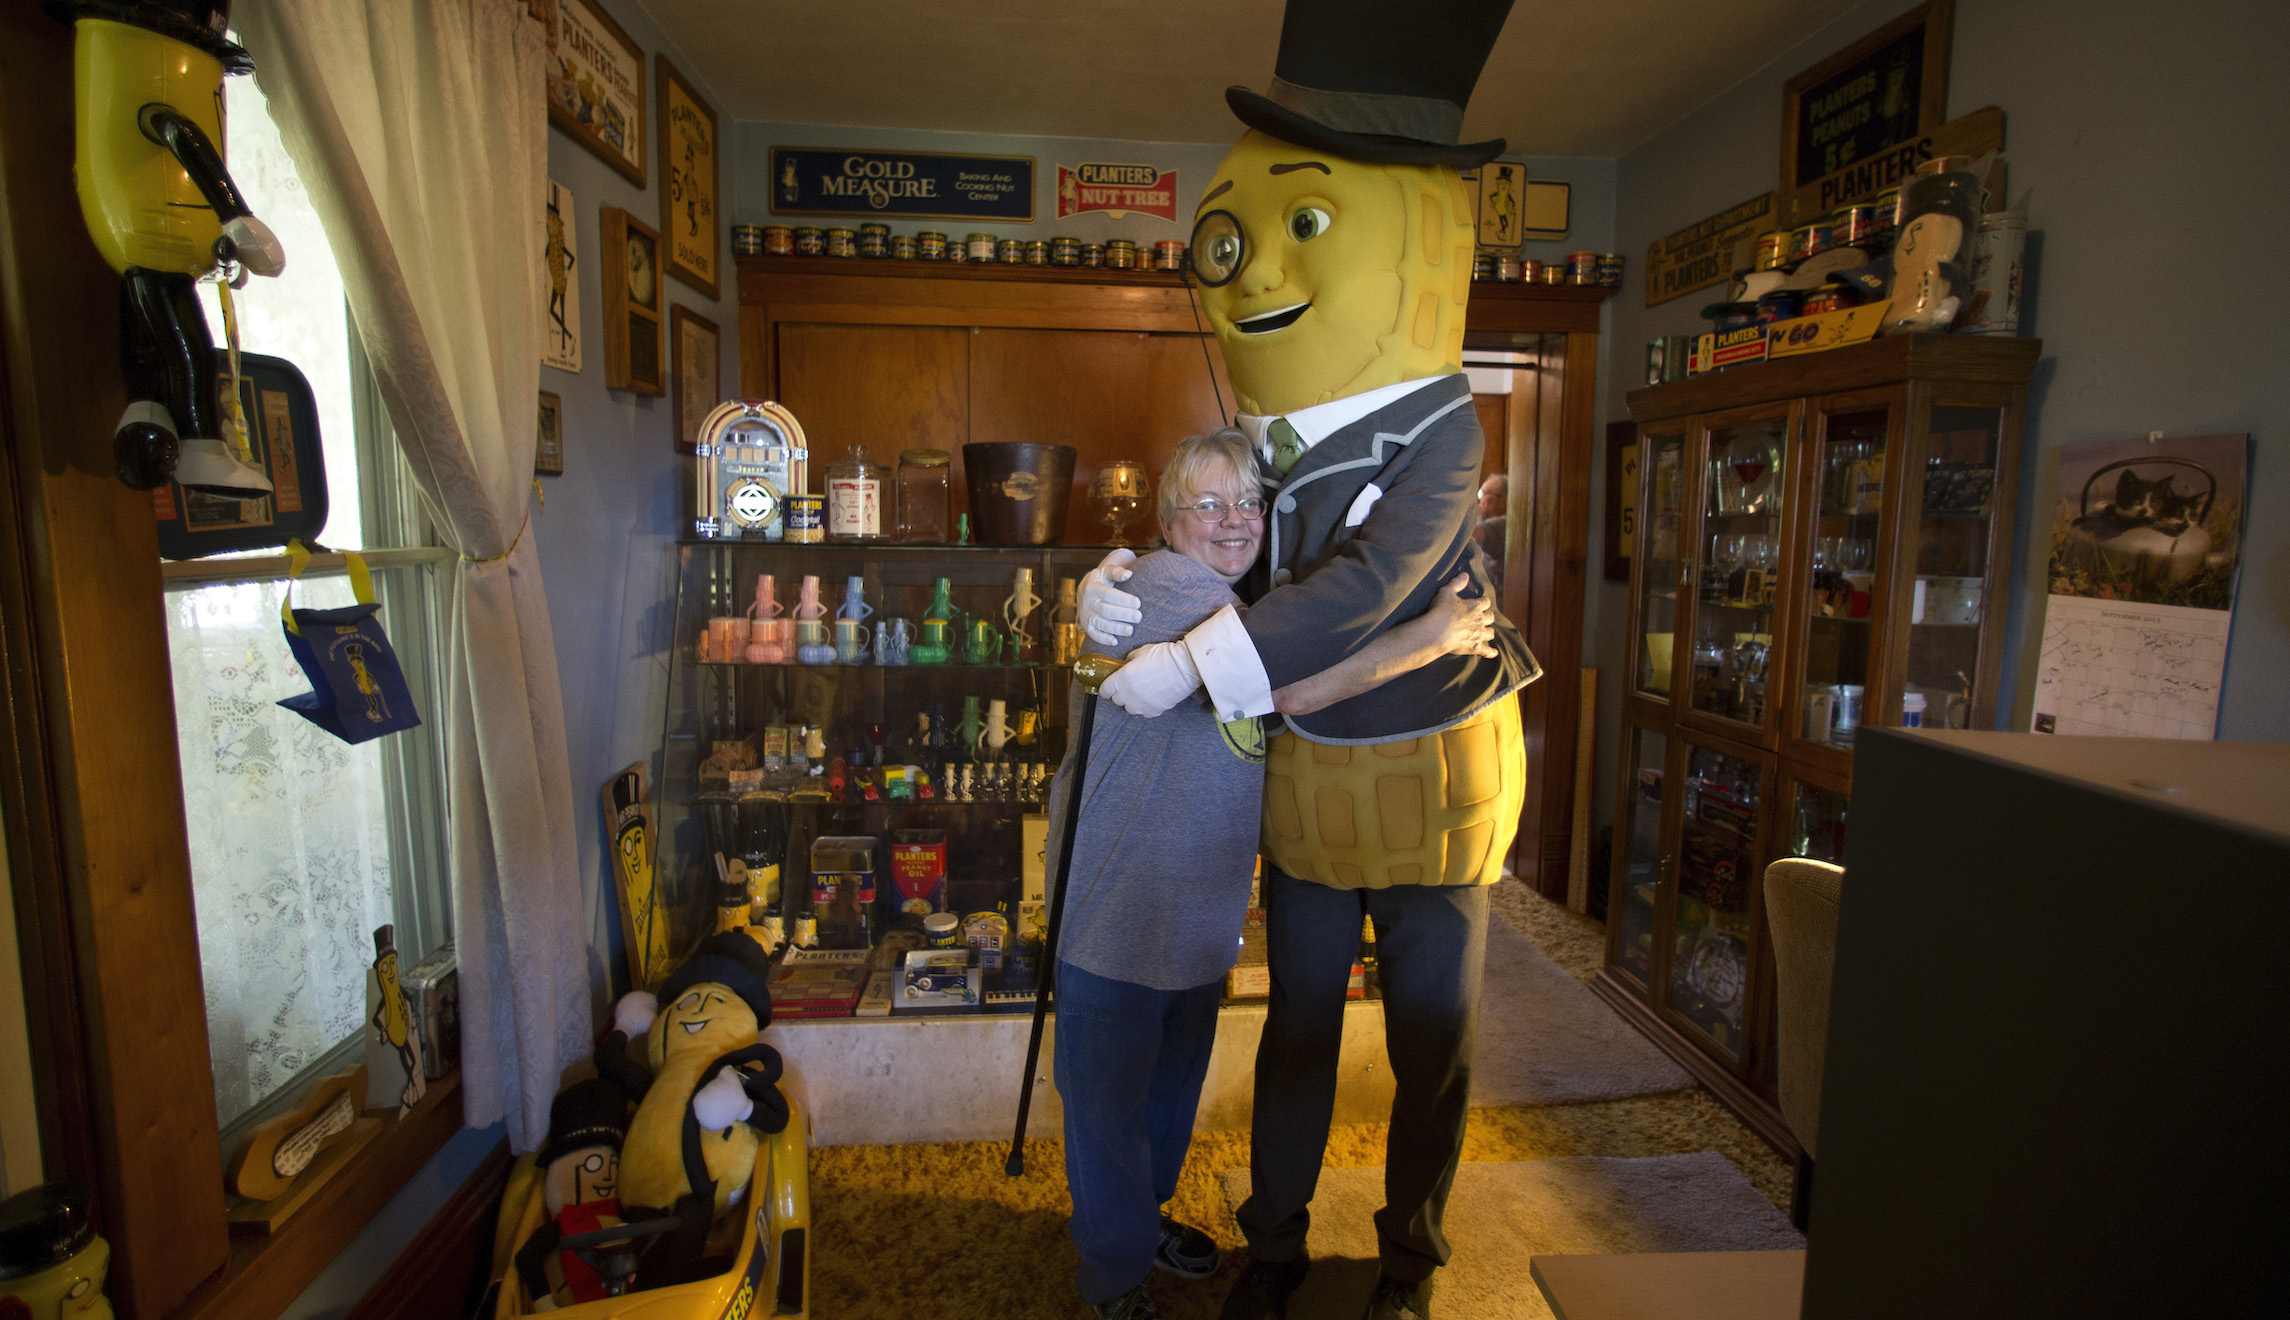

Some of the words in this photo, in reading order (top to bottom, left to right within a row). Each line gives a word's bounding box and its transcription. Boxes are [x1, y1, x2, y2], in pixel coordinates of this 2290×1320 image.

[562, 17, 613, 84] PLANTERS
[1810, 70, 1877, 122] PLANTERS
[1812, 101, 1870, 148] PEANUTS
[843, 156, 915, 179] GOLD
[1083, 165, 1153, 183] PLANTERS
[1820, 137, 1933, 210] PLANTERS
[821, 175, 938, 209] MEASURE
[1081, 189, 1120, 204] NUT
[1122, 190, 1170, 206] TREE
[1665, 251, 1719, 294] PLANTERS
[1718, 325, 1760, 347] PLANTERS
[1624, 508, 1634, 534] 5
[2100, 610, 2142, 622] SEPTEMBER
[895, 851, 938, 861] PLANTERS
[795, 951, 859, 960] PLANTERS
